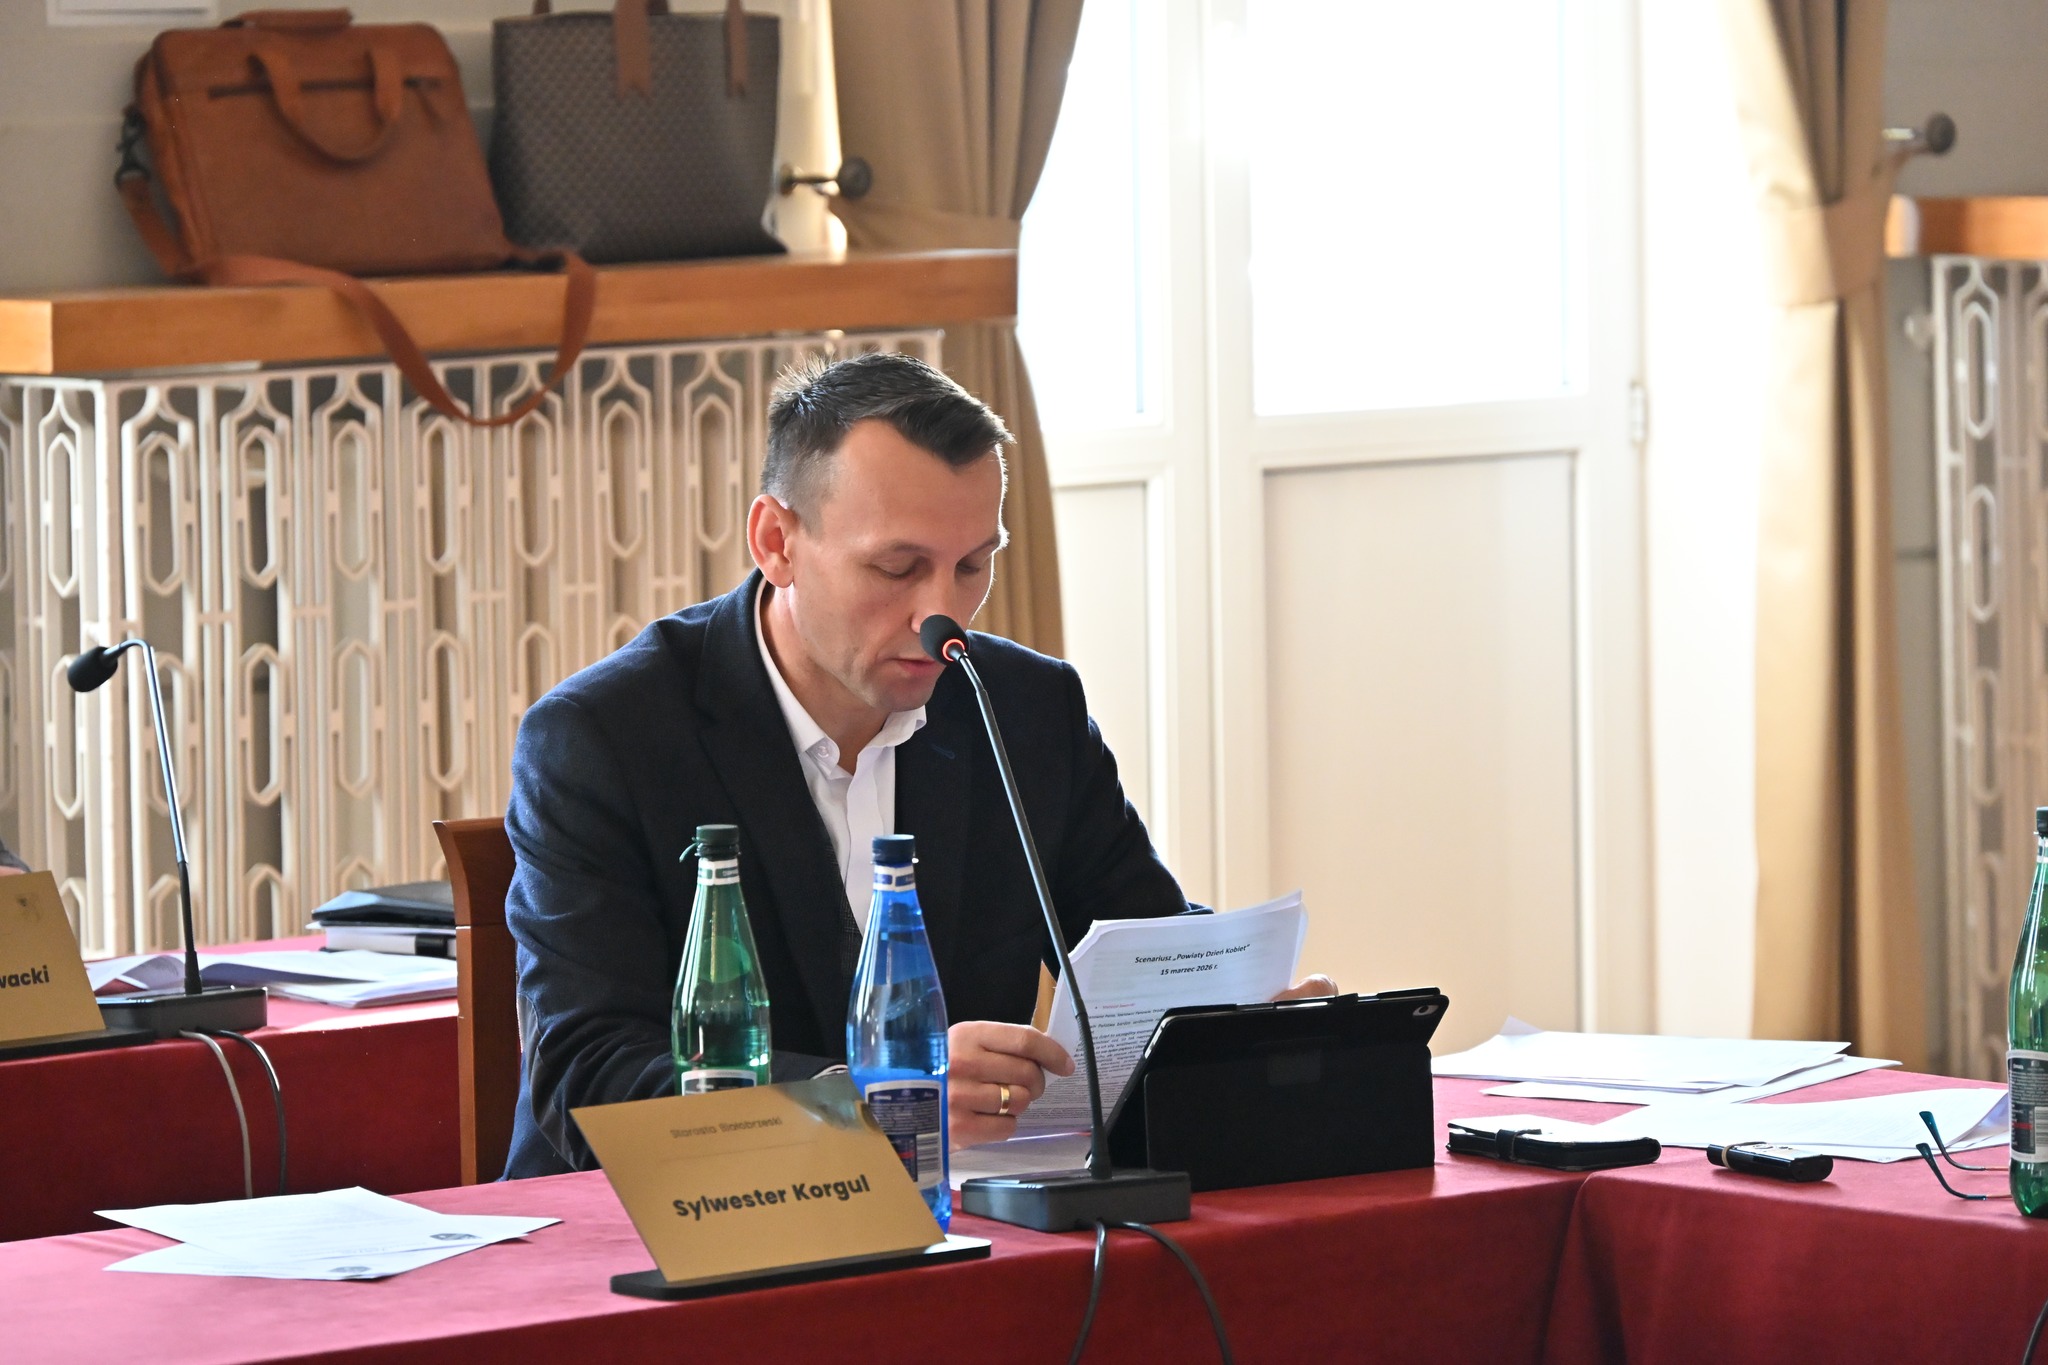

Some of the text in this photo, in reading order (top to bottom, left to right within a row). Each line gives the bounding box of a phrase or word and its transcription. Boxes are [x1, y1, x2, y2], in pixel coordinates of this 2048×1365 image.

[1135, 955, 1172, 963] Scenariusz
[1206, 949, 1225, 957] Dzień
[1160, 968, 1169, 976] 15
[1170, 966, 1195, 975] marzec
[1196, 963, 1213, 972] 2026
[670, 1126, 717, 1138] Starosta
[673, 1174, 871, 1221] Sylwester Korgul
